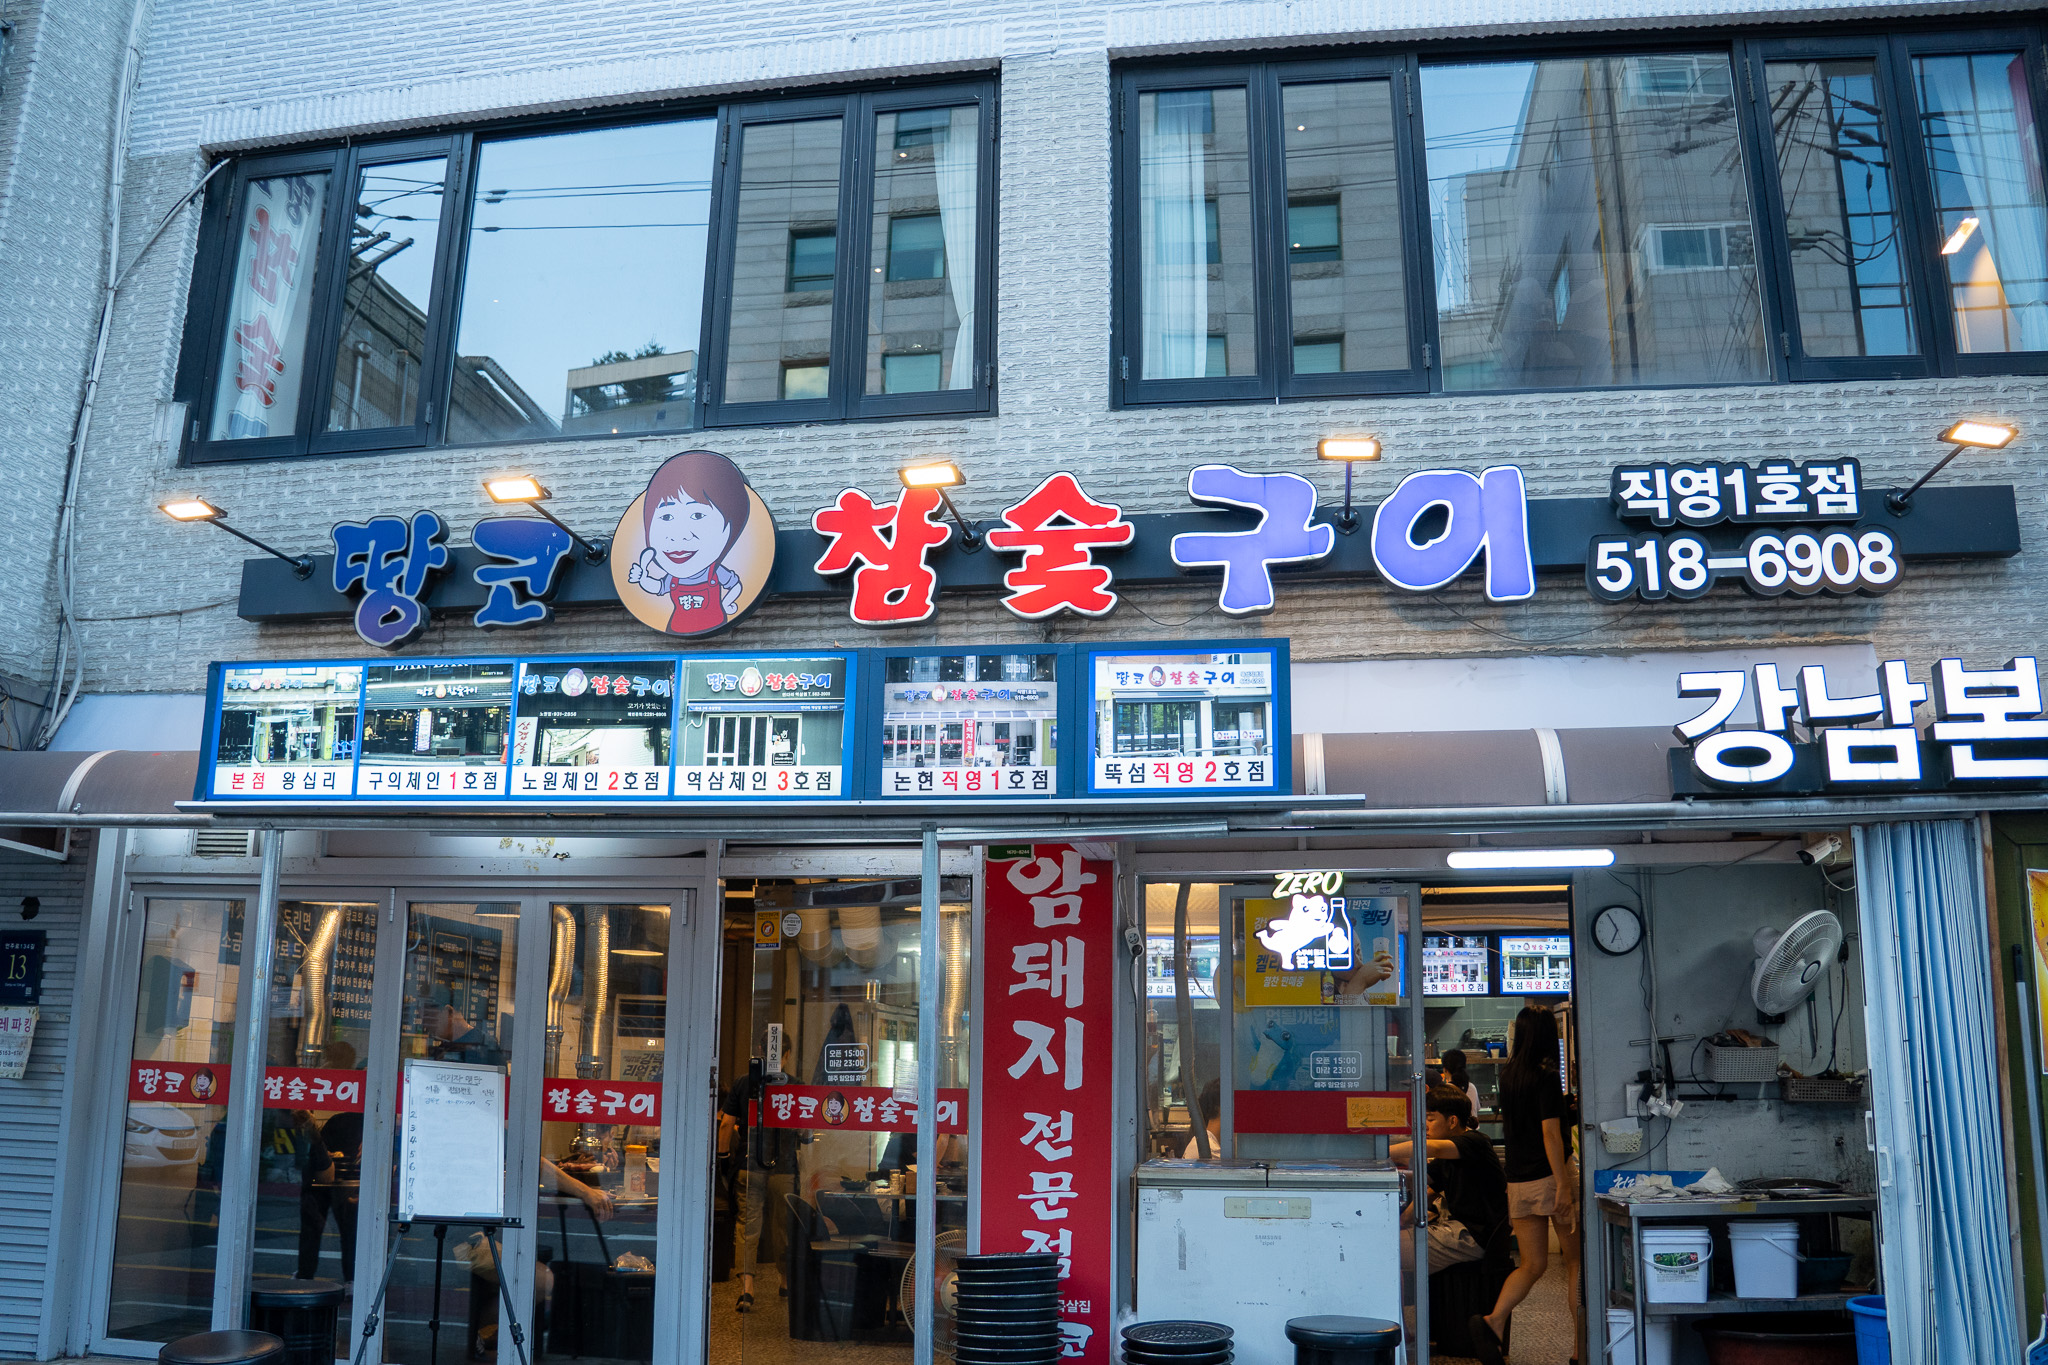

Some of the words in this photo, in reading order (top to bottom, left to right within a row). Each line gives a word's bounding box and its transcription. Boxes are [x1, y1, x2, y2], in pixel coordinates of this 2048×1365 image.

[1619, 463, 1859, 519] 직영1호점
[331, 509, 573, 647] 땅코
[811, 465, 1536, 627] 참숯구이
[1596, 530, 1898, 593] 518-6908
[677, 594, 705, 611] 땅코
[590, 674, 671, 697] 참숯구이
[765, 672, 832, 691] 참숯구이
[1170, 670, 1235, 685] 참숯구이
[231, 772, 266, 790] 본점
[282, 772, 336, 790] 왕십리
[1271, 871, 1344, 899] ZERO
[1361, 909, 1393, 926] 켈리
[7, 954, 27, 979] 13
[769, 1025, 778, 1061] 당기시오
[829, 1049, 842, 1058] 오픈
[844, 1049, 865, 1058] 15:00
[829, 1059, 842, 1068] 마감
[843, 1059, 865, 1068] 23:00
[1315, 1057, 1331, 1065] 오픈
[1315, 1066, 1331, 1074] 마감
[1333, 1066, 1357, 1074] 23:00
[138, 1068, 185, 1095] 땅코
[264, 1076, 359, 1104] 참숯구이
[547, 1088, 655, 1118] 참숯구이
[771, 1093, 819, 1120] 땅코
